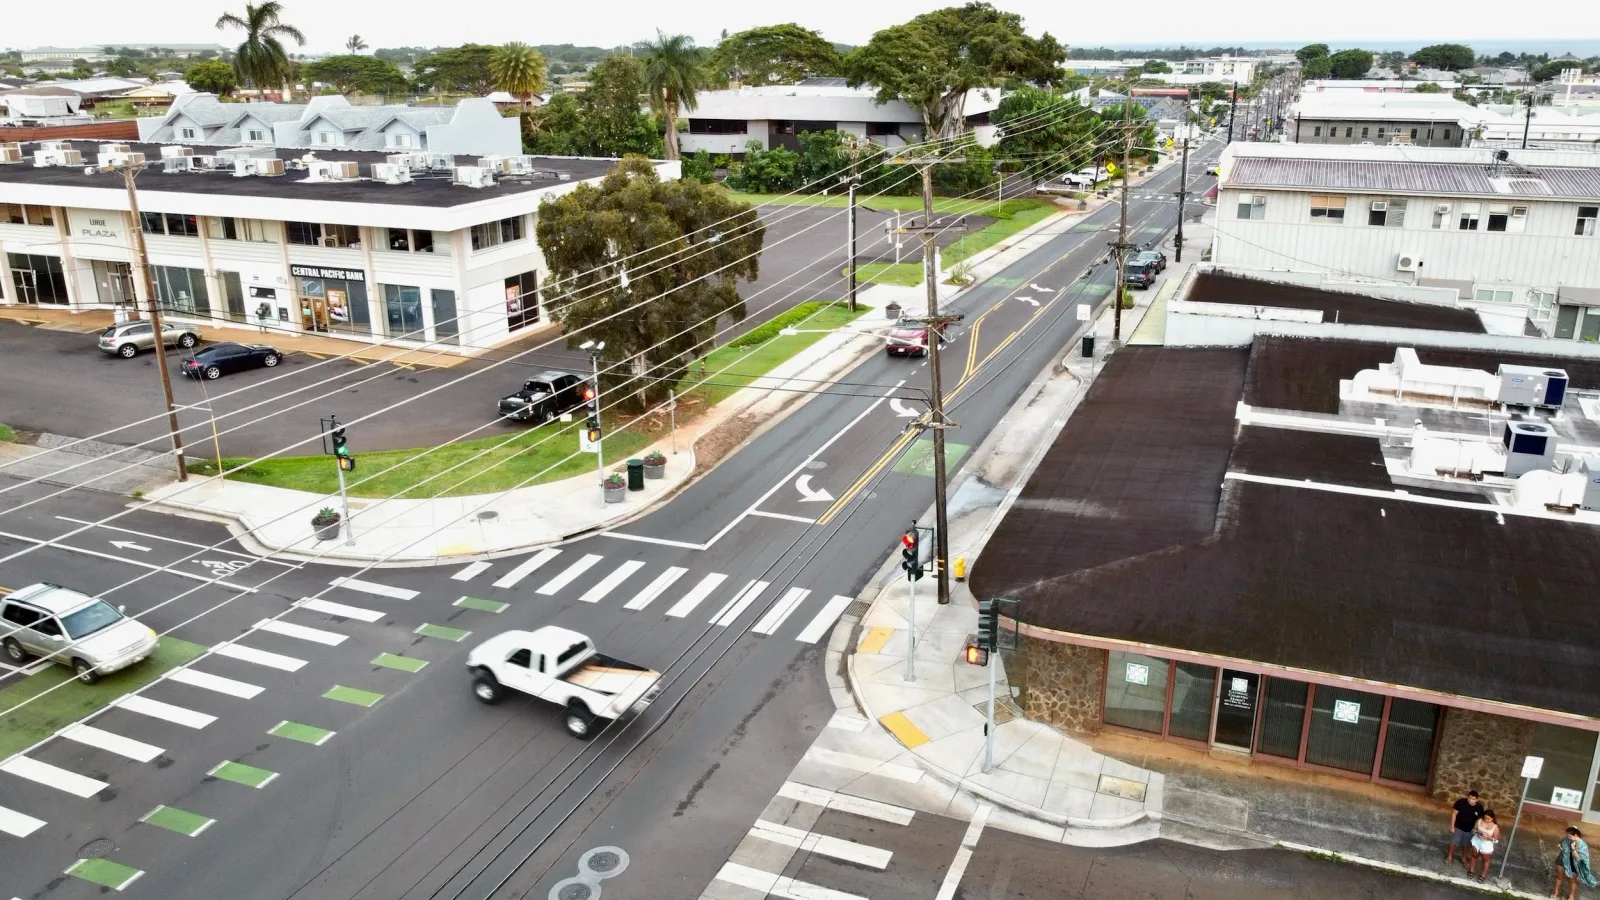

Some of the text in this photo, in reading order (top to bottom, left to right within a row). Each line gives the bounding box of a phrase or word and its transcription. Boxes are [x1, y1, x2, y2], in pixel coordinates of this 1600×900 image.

[82, 229, 117, 238] PLAZA
[292, 267, 364, 281] CENTRAL PACIFIC BANK
